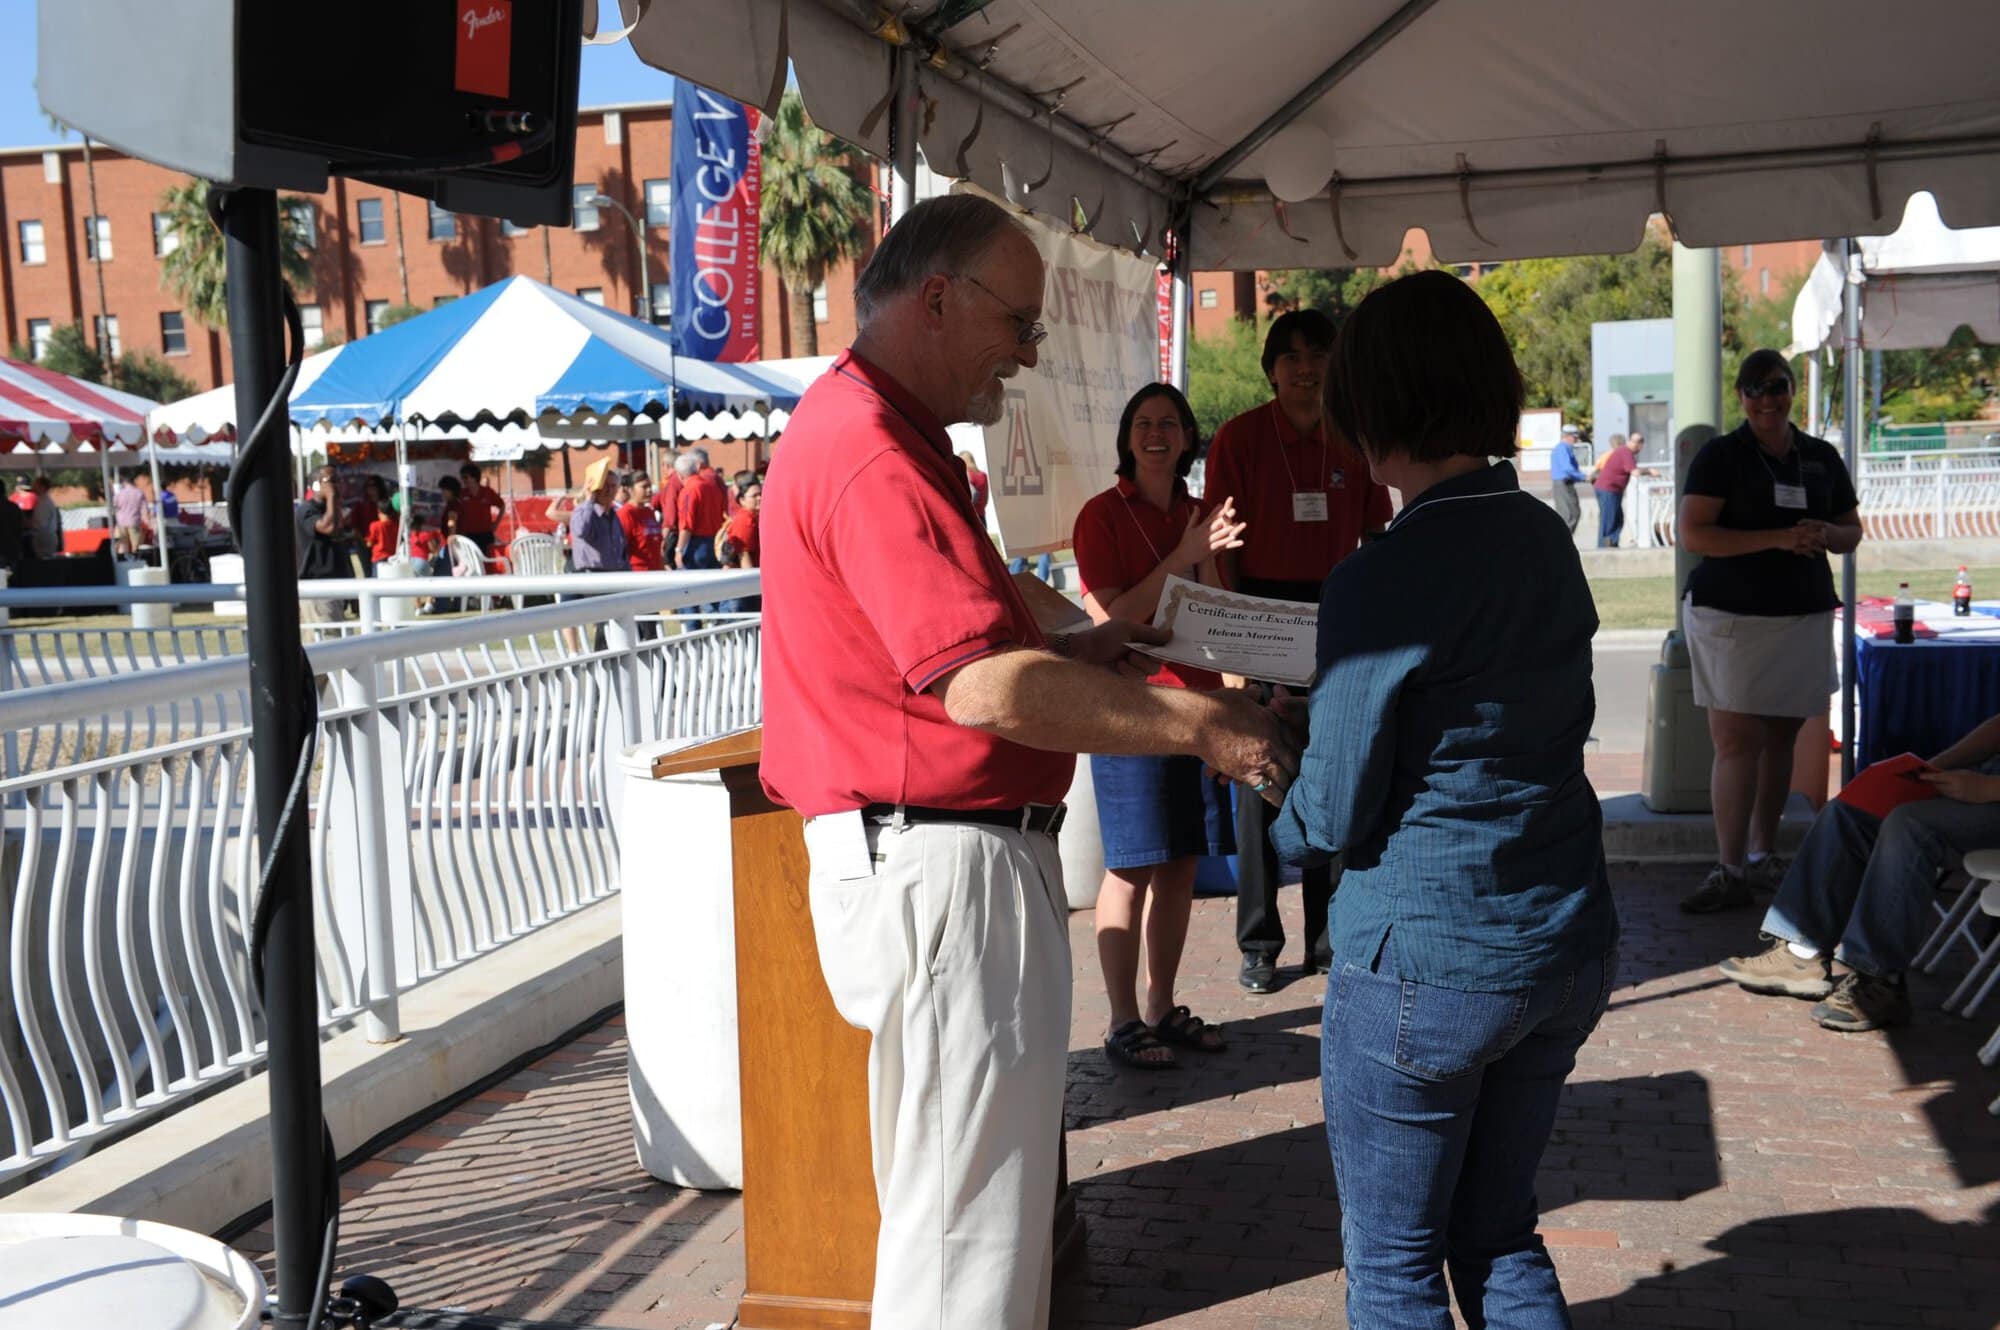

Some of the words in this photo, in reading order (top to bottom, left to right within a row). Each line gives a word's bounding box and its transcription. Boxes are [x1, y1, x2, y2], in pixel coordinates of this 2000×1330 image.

[462, 7, 505, 40] Fender
[692, 138, 739, 340] COLLEGE
[742, 313, 754, 337] THE
[1187, 602, 1249, 620] Certificate
[1251, 613, 1264, 622] of
[1208, 628, 1242, 638] Helena
[1246, 631, 1294, 642] Morrison
